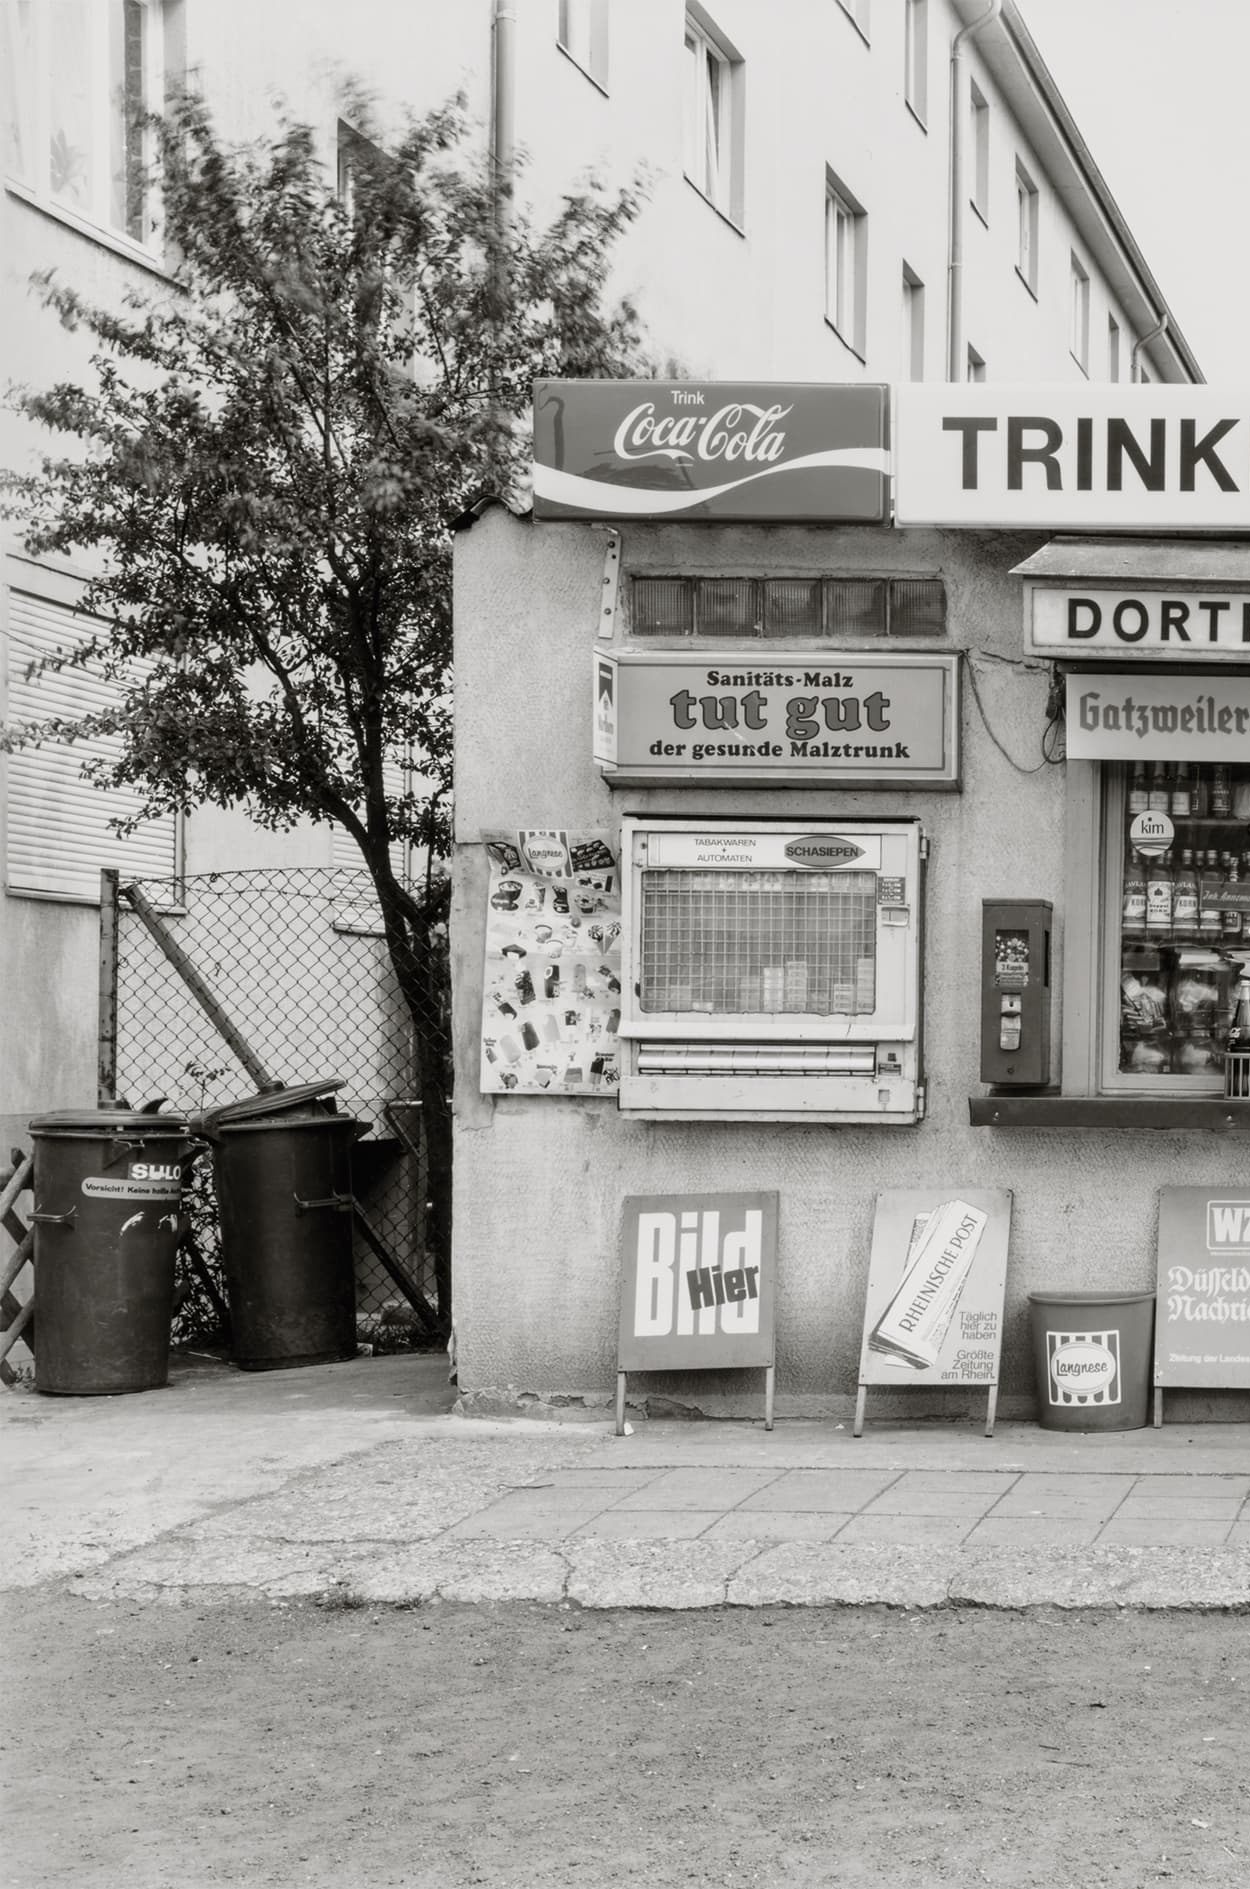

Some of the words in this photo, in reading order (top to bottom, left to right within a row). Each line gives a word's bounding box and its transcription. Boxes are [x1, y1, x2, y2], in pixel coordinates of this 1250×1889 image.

[670, 390, 705, 405] Trink
[613, 402, 794, 462] Coca-Cola
[706, 670, 854, 688] Sanitäts-Malz
[669, 689, 768, 730] tut
[785, 691, 891, 741] gut
[649, 740, 687, 757] der
[692, 741, 784, 760] gesunde
[789, 741, 911, 758] Malztrunk
[1141, 816, 1165, 835] kim
[694, 838, 757, 848] TABAKWAREN
[697, 854, 753, 863] AUTOMATEN
[786, 846, 859, 858] SCHASIEPEN
[85, 1182, 125, 1193] Vorsicht!
[633, 1209, 763, 1337] Bild
[898, 1247, 960, 1333] RHEINISCHE
[949, 1212, 979, 1251] POST
[686, 1264, 760, 1311] Hier
[959, 1311, 997, 1324] Täglich
[960, 1320, 981, 1331] hier
[983, 1322, 997, 1331] zu
[962, 1329, 997, 1340] haben
[952, 1359, 994, 1372] Zeitung
[1056, 1359, 1108, 1377] Langnese
[941, 1370, 959, 1380] am
